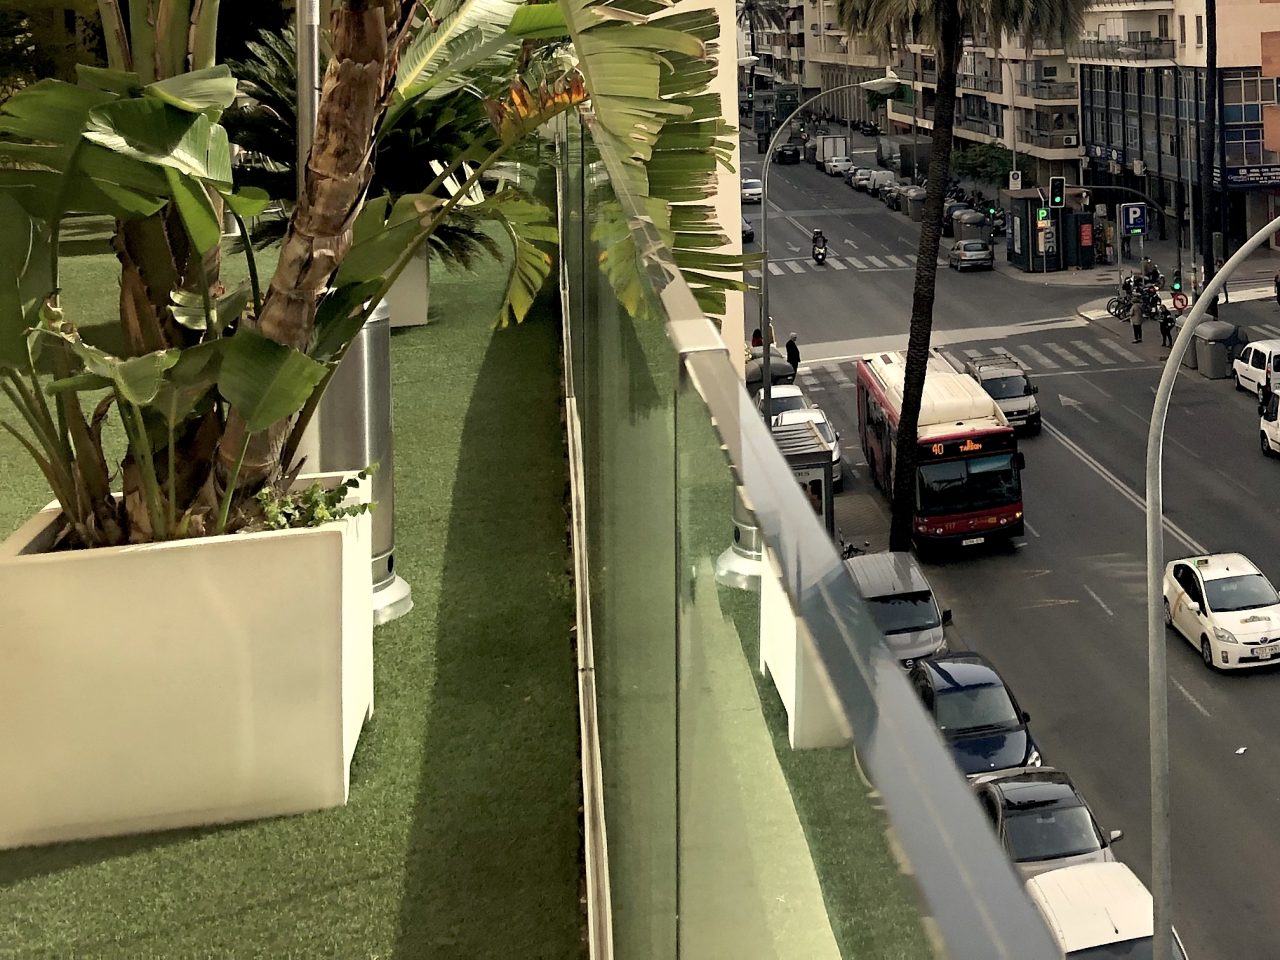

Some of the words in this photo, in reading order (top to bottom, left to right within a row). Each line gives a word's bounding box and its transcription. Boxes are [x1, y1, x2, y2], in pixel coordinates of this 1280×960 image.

[1039, 210, 1048, 221] P
[1129, 208, 1141, 224] P
[931, 443, 944, 456] 40
